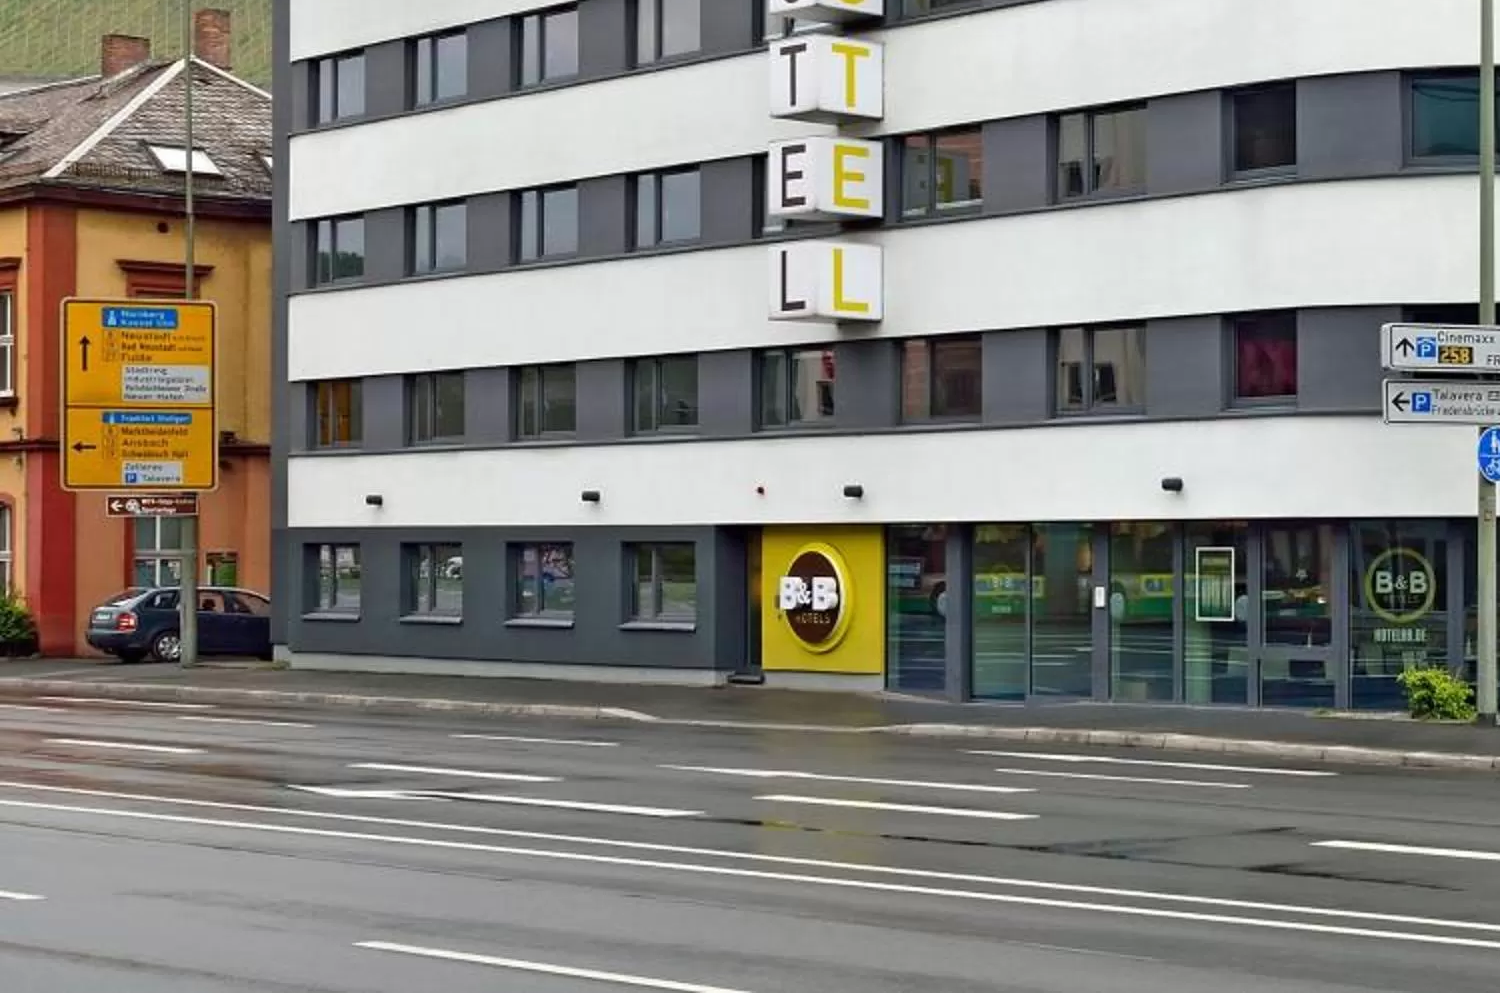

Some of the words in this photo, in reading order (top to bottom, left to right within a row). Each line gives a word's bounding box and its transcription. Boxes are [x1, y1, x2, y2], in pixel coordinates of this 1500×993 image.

[1437, 331, 1496, 344] Cinemaxx
[1440, 348, 1471, 362] 258
[1432, 388, 1483, 401] Talavera
[1376, 571, 1427, 594] B&B
[779, 576, 838, 611] B&B
